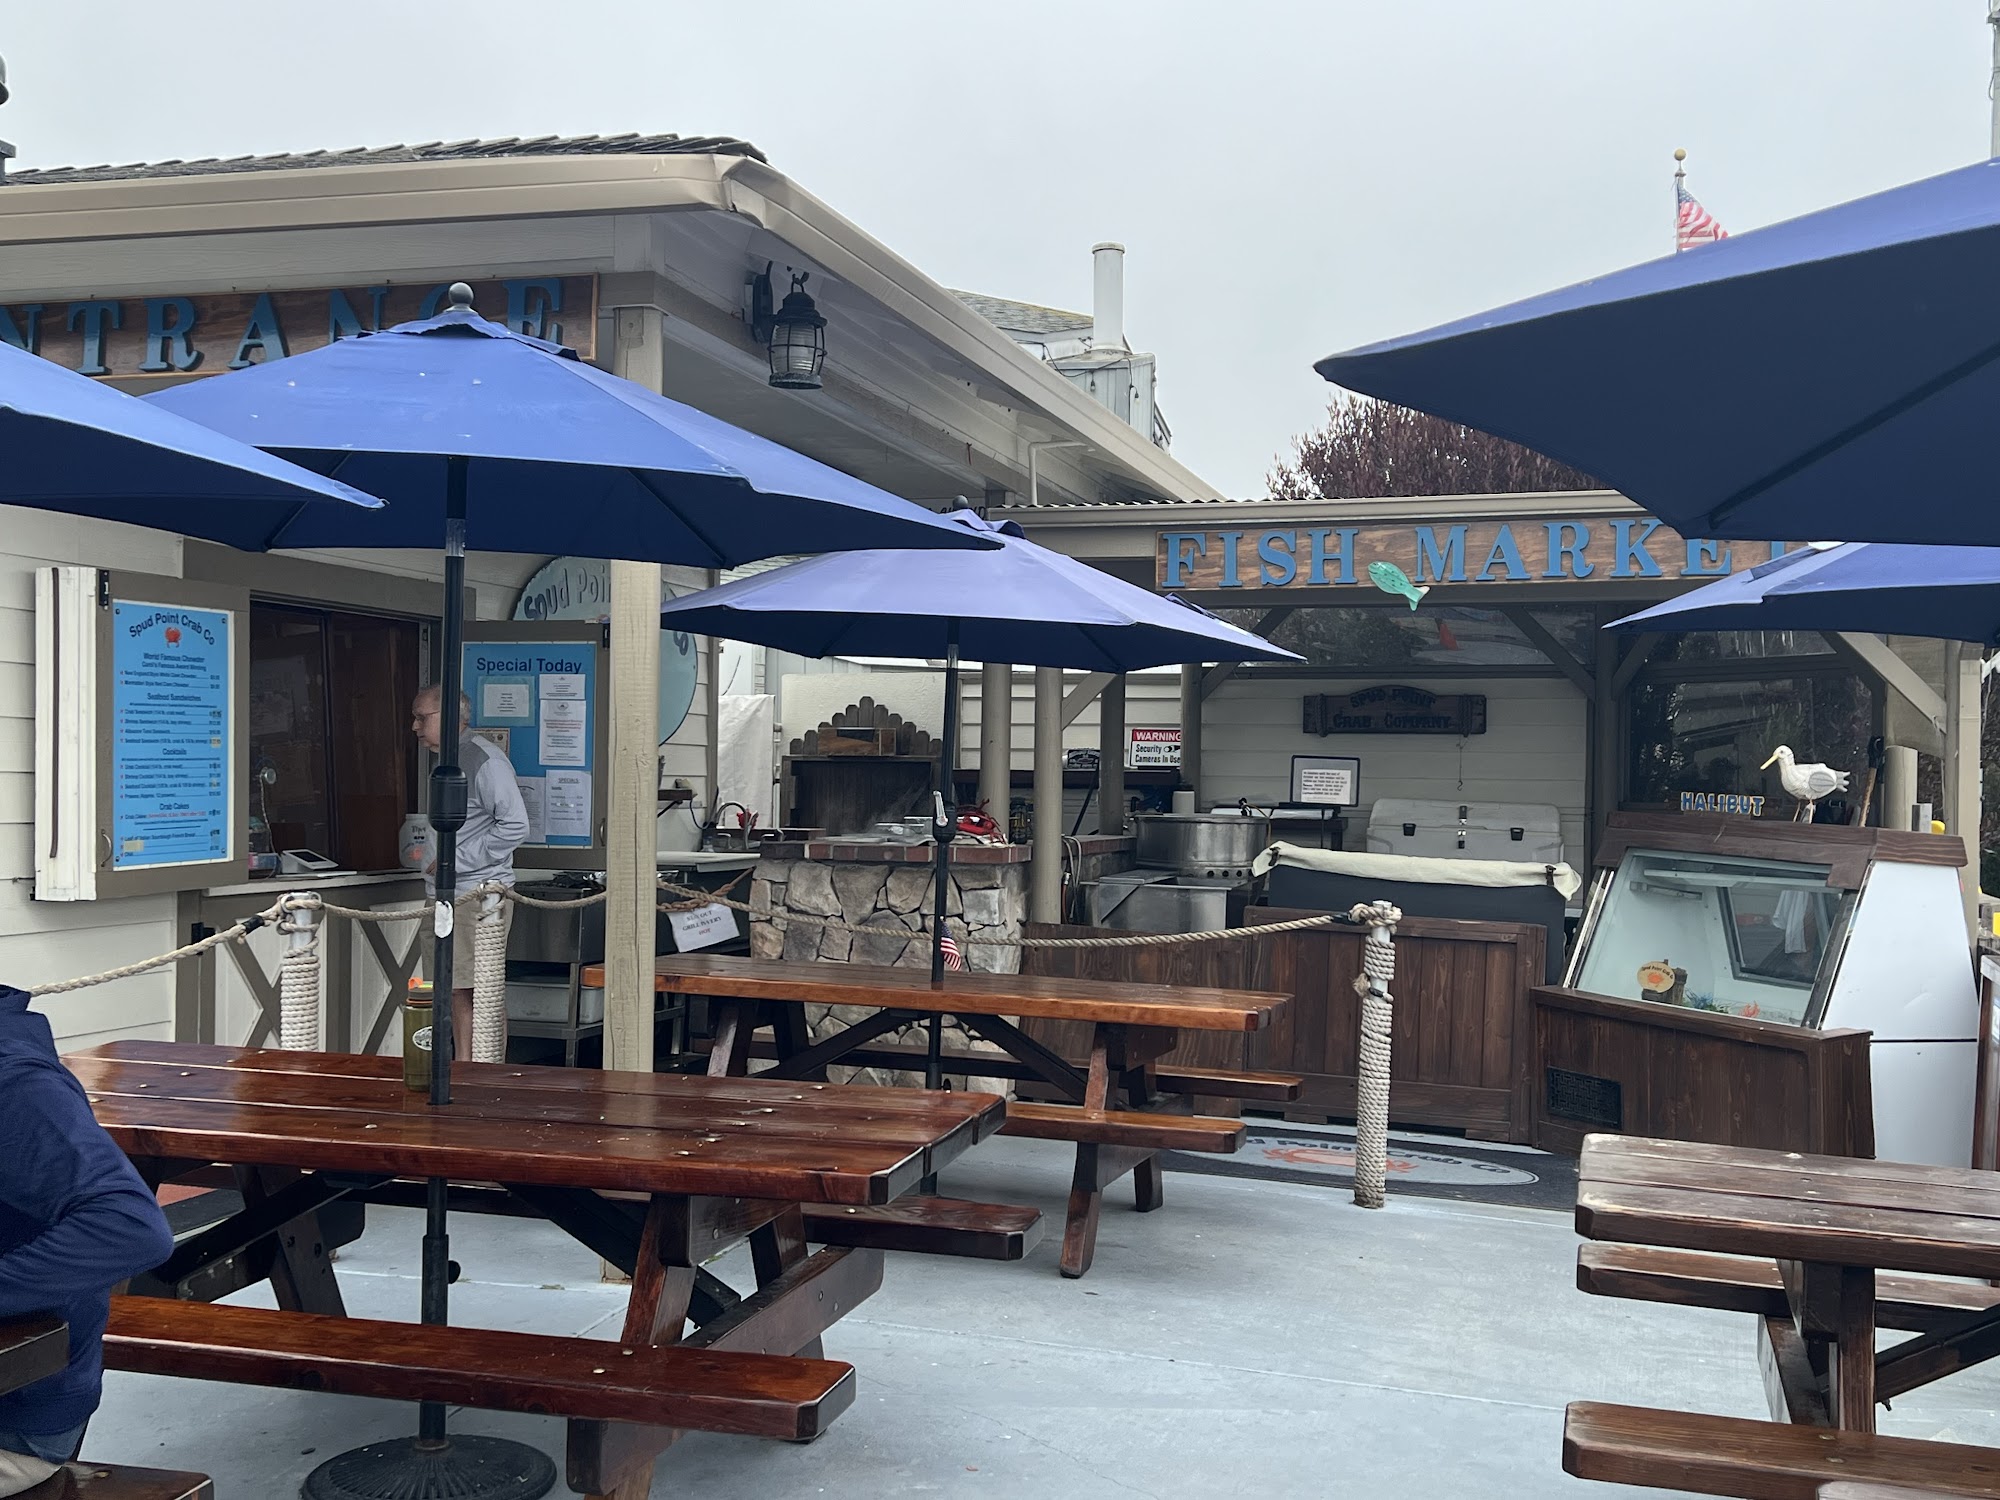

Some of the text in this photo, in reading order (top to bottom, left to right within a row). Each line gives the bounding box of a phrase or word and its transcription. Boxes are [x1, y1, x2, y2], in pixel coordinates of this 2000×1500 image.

[1161, 528, 1359, 588] FISH
[129, 612, 215, 645] Spud Point Crab Co
[476, 657, 582, 675] Special Today
[1136, 731, 1181, 741] WARNING
[1135, 743, 1162, 755] Security
[1135, 754, 1161, 763] Cameras
[1169, 755, 1181, 764] Use
[1681, 791, 1765, 817] HALIBUT
[1277, 1139, 1352, 1151] Poin
